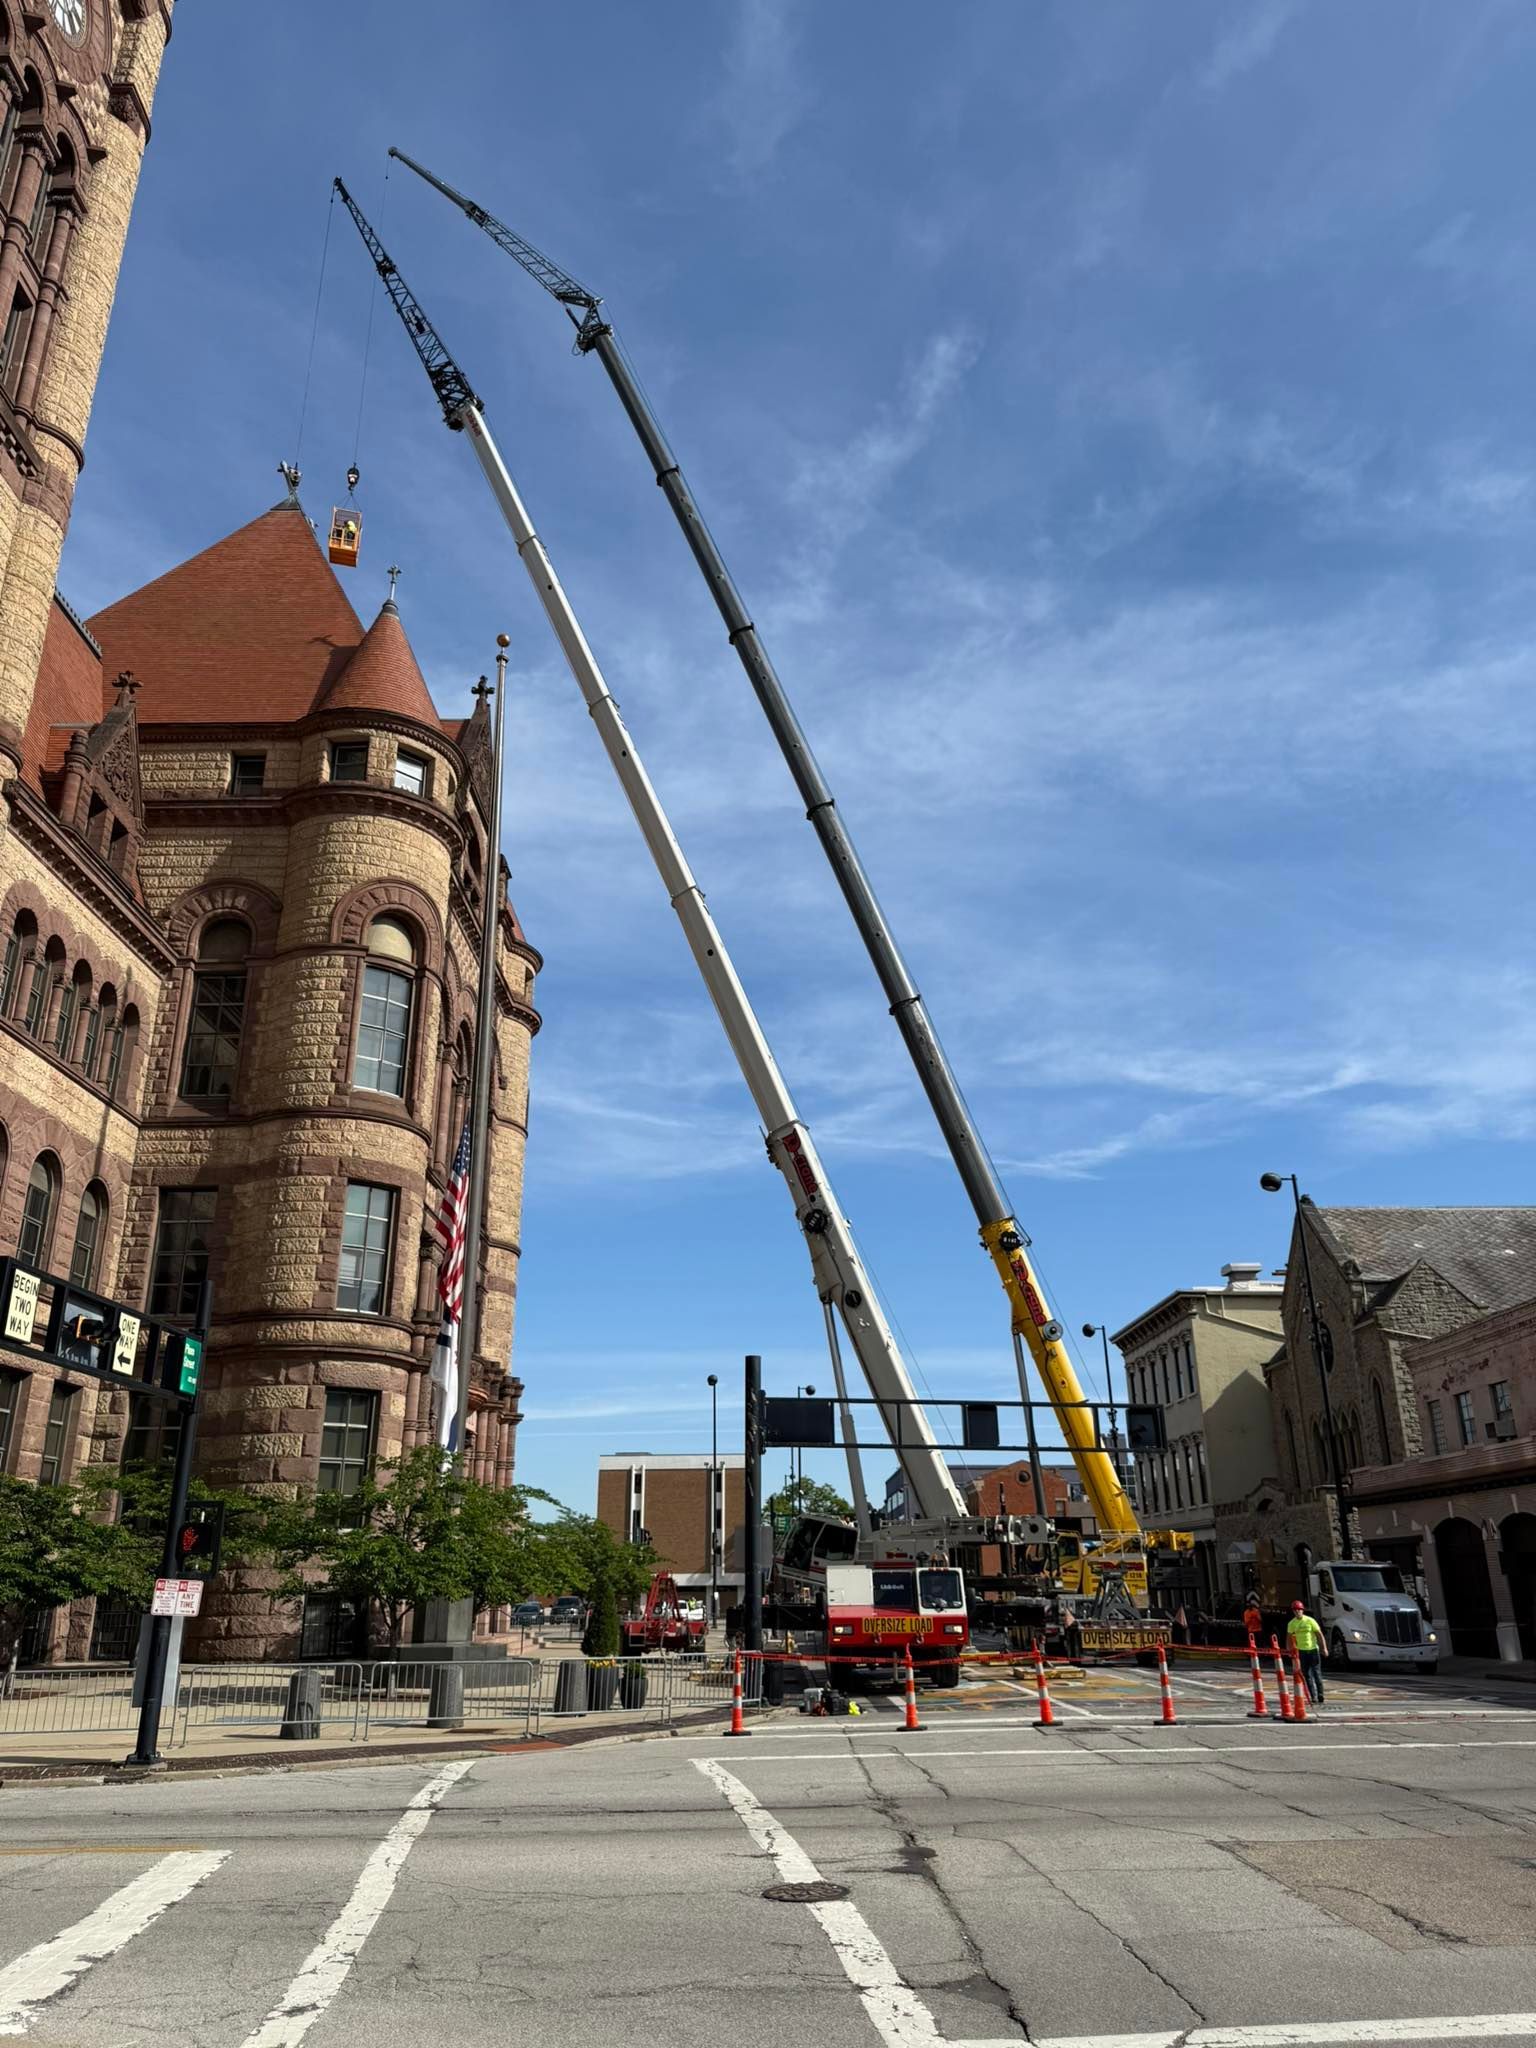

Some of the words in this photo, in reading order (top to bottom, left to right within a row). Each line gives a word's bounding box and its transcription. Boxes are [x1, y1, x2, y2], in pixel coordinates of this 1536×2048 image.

[13, 1274, 39, 1296] BEGIN
[15, 1296, 32, 1316] TWO
[9, 1315, 29, 1336] WAY
[122, 1318, 136, 1335] ONE
[119, 1334, 134, 1348] WAY
[864, 1617, 906, 1632] OVERSIZE
[910, 1617, 933, 1632] LOAD
[1083, 1631, 1137, 1645] OVERSIZE
[1143, 1631, 1170, 1645] LOAD
